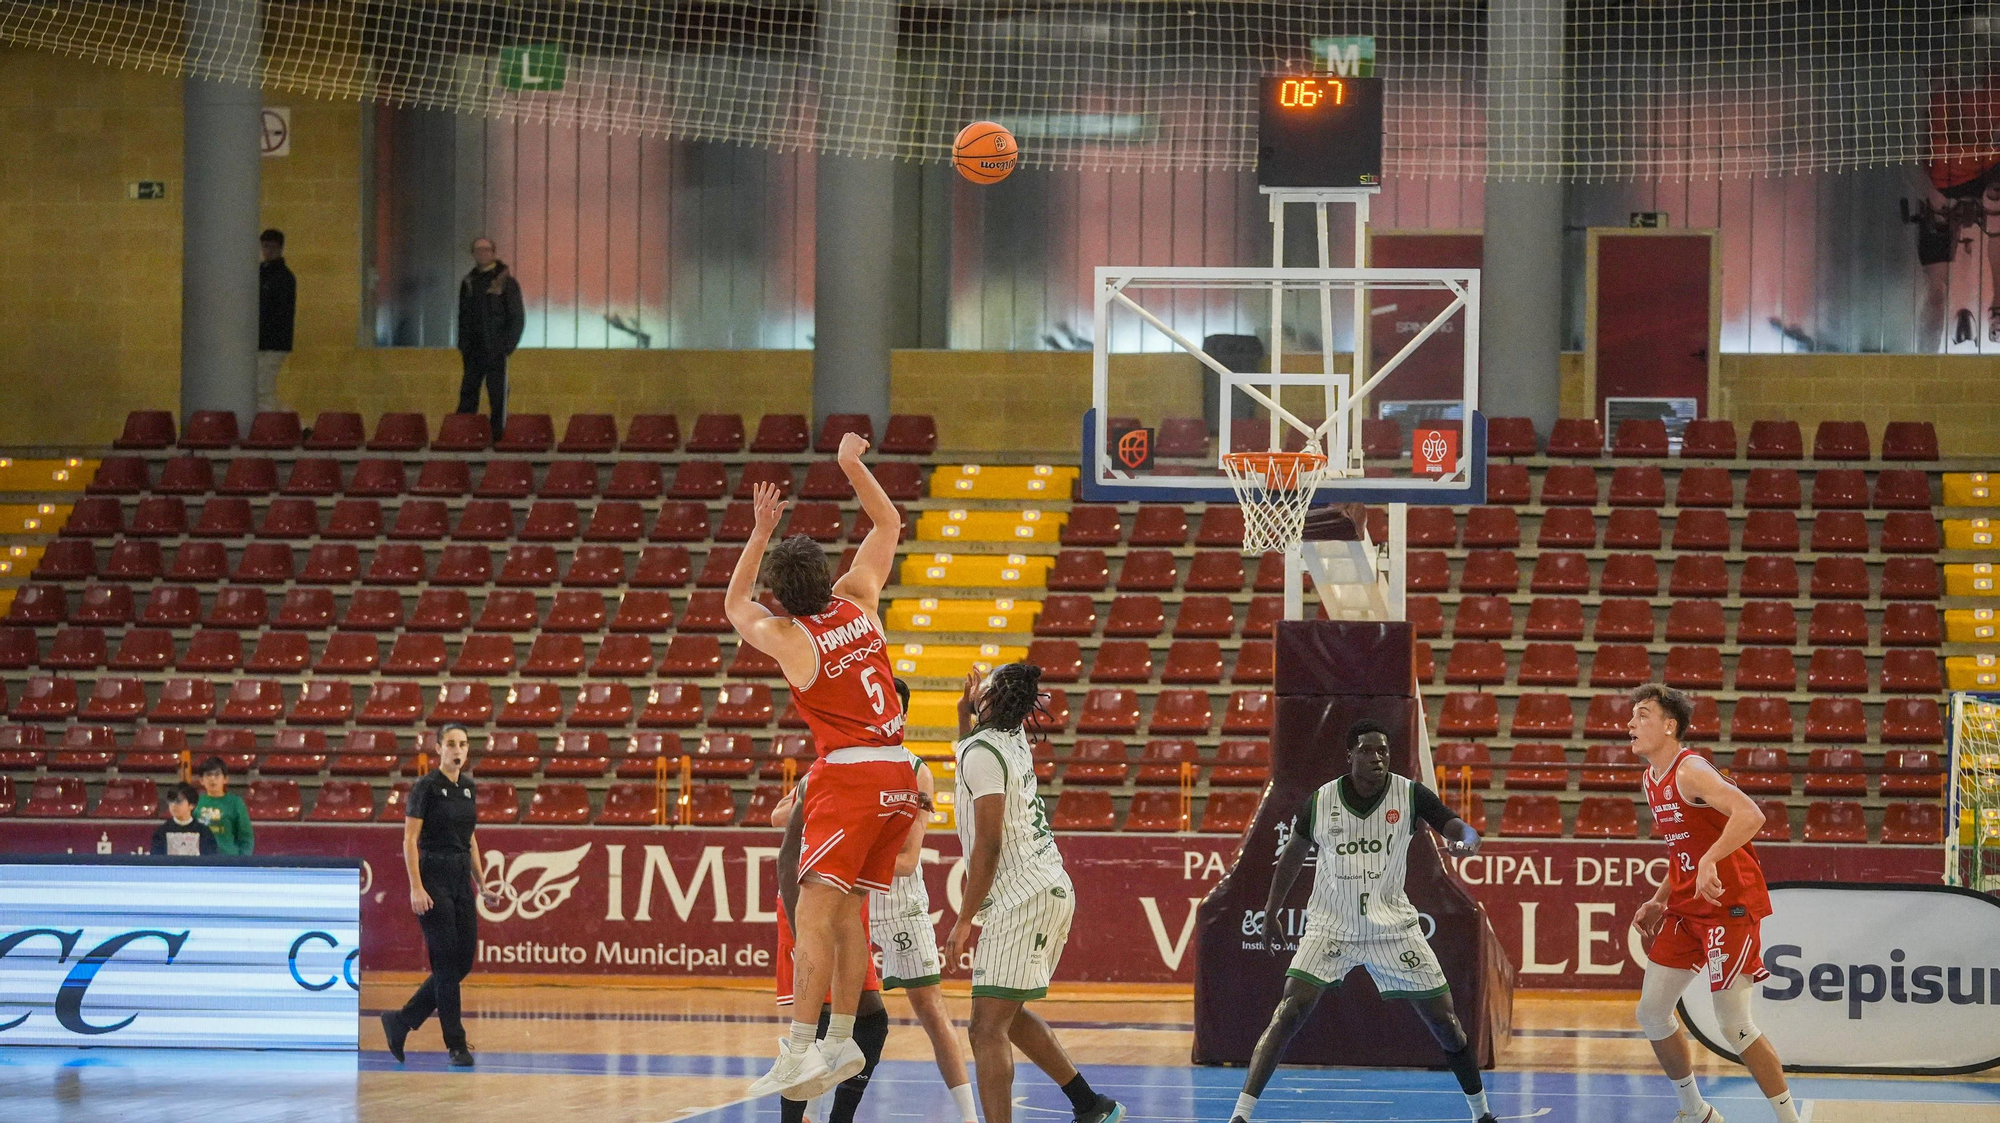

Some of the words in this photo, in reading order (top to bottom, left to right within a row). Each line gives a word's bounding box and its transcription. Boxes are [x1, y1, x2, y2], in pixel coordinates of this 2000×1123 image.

[522, 53, 544, 84] L
[1327, 44, 1361, 76] M
[816, 613, 873, 655] HAYMAN
[860, 666, 885, 715] 5
[1336, 837, 1382, 855] coto
[1574, 857, 1670, 887] DEPO
[1707, 926, 1725, 949] 32
[477, 939, 587, 964] Instituto
[595, 941, 727, 971] Municipal
[735, 944, 769, 967] de
